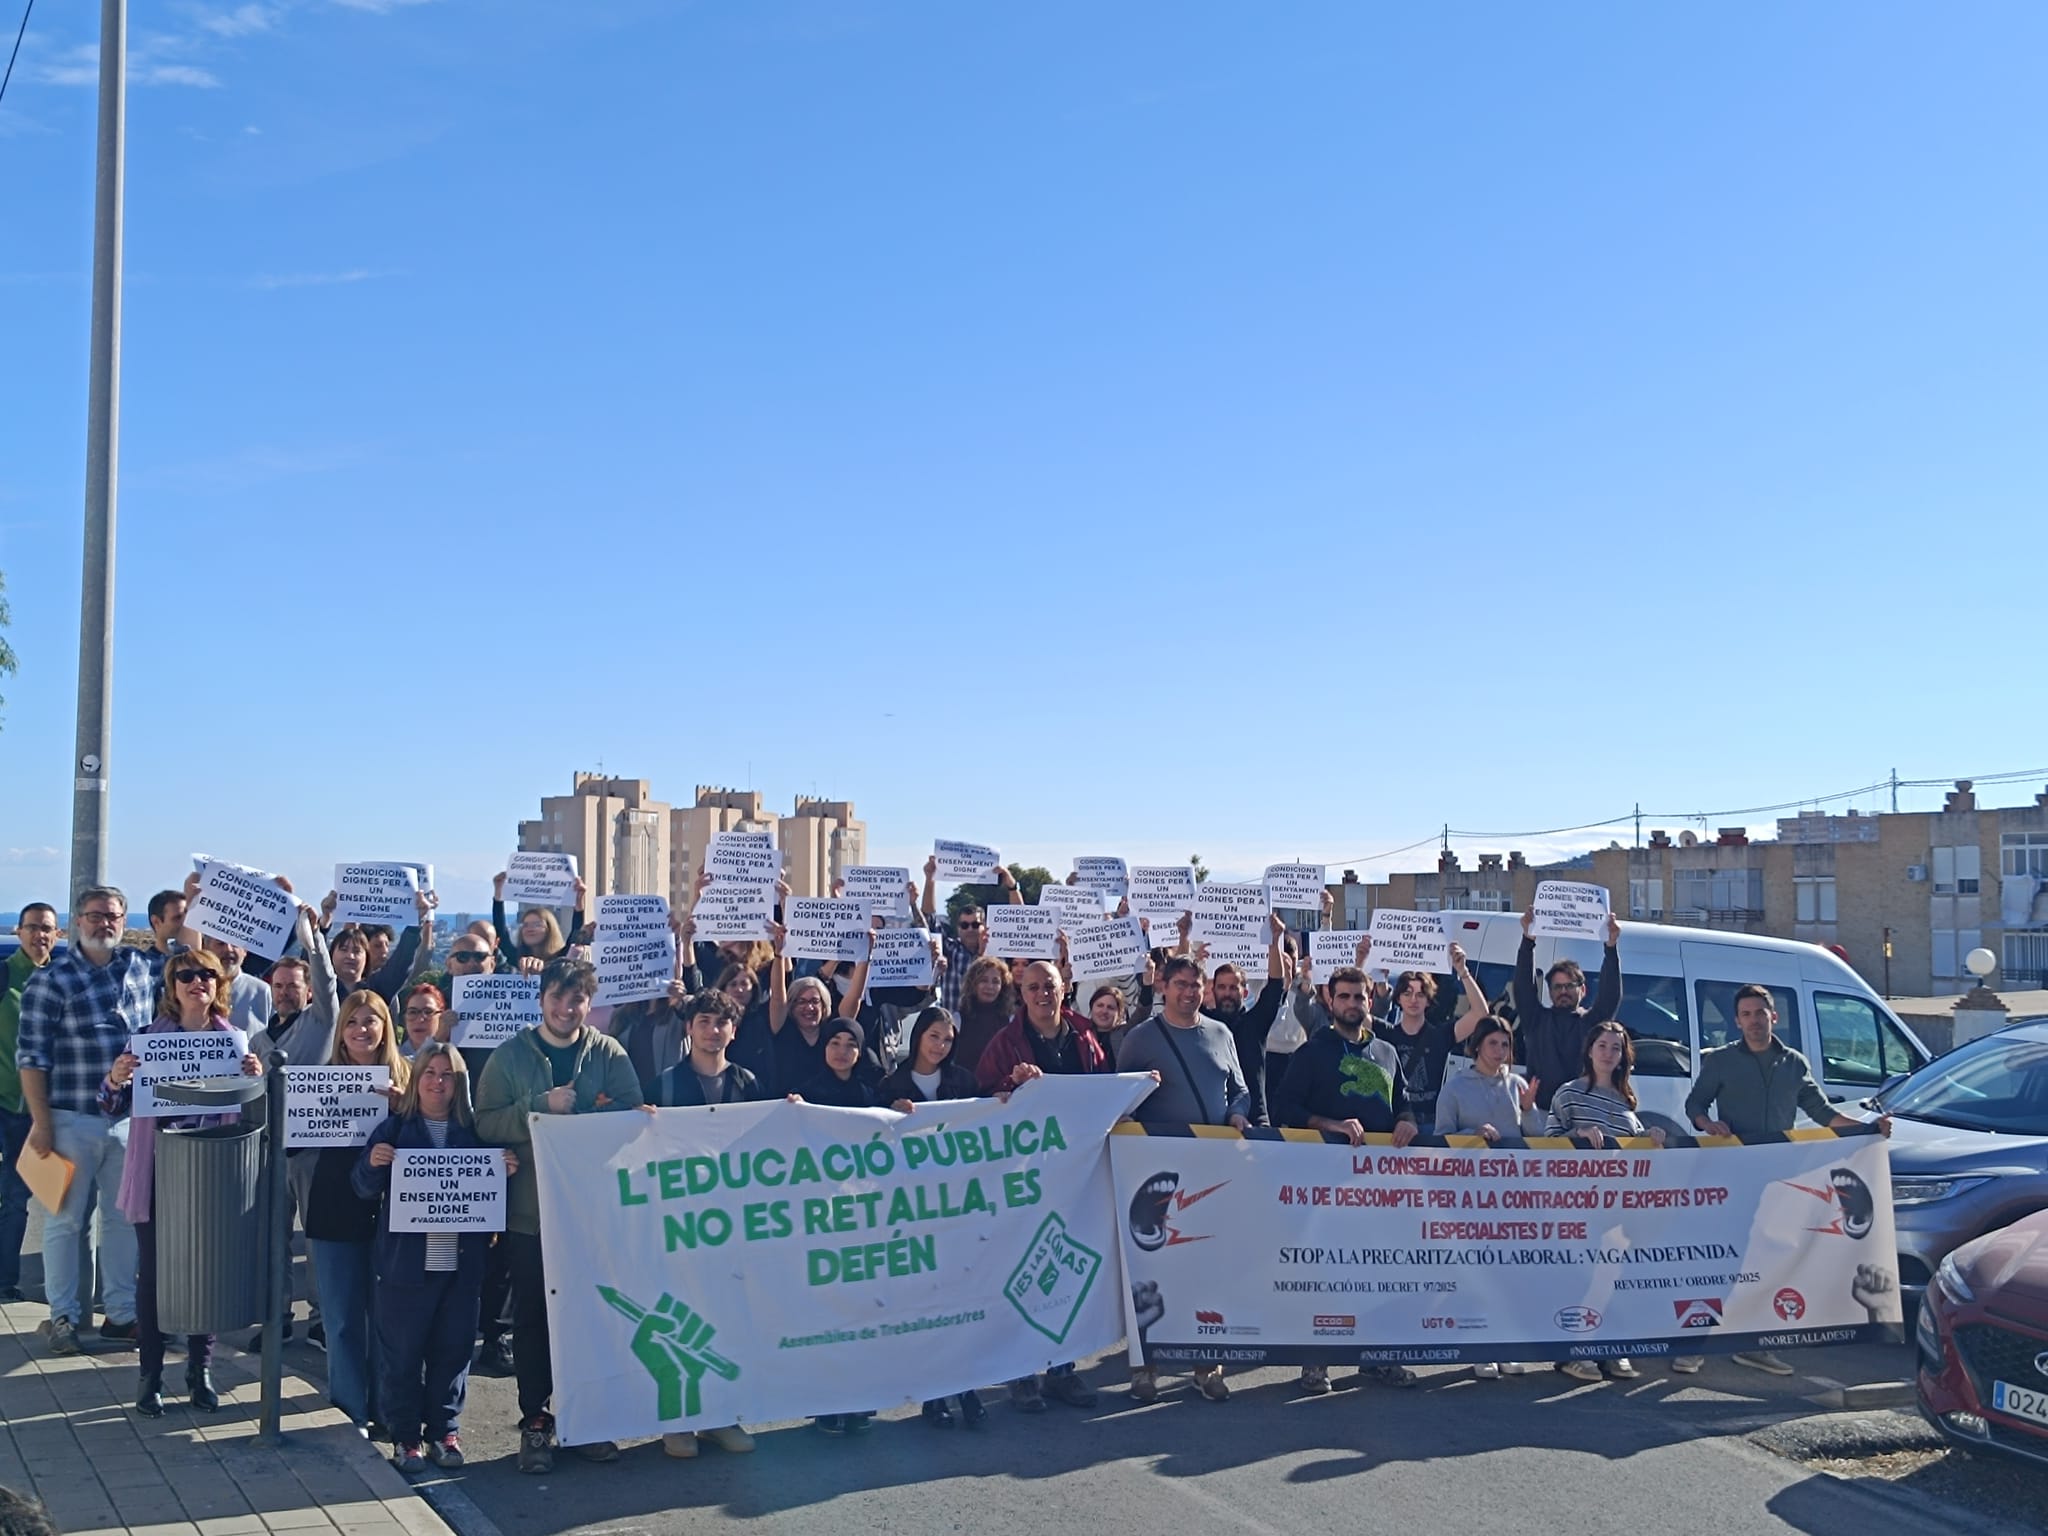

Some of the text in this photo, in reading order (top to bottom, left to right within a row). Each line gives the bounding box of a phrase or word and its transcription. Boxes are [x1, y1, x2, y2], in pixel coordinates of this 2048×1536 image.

[346, 867, 407, 878] CONDICIONS
[218, 870, 288, 904] CONDICIONS
[343, 876, 380, 885] DIGNES
[383, 879, 401, 887] PER
[210, 878, 287, 915] DIGNES PER A
[1202, 886, 1262, 896] CONDICIONS
[339, 894, 413, 905] ENSENYAMENT
[603, 898, 659, 906] CONDICIONS
[1198, 895, 1234, 904] DIGNES
[1237, 897, 1255, 905] PER
[236, 900, 254, 912] UN
[360, 904, 391, 912] DIGNE
[601, 906, 634, 914] DIGNES
[797, 902, 860, 911] CONDICIONS
[199, 896, 283, 935] ENSENYAMENT
[793, 911, 831, 919] DIGNES
[834, 912, 853, 920] PER
[1195, 912, 1267, 923] ENSENYAMENT
[1380, 913, 1442, 924] CONDICIONS
[218, 915, 255, 936] DIGNE
[600, 922, 666, 931] ENSENYAMENT
[1075, 921, 1132, 936] CONDICIONS
[1215, 922, 1245, 931] DIGNE
[1376, 922, 1412, 932] DIGNES
[1416, 925, 1434, 933] PER
[790, 929, 864, 939] ENSENYAMENT
[1073, 933, 1107, 945] DIGNES
[1110, 931, 1126, 939] PER
[603, 940, 665, 954] CONDICIONS
[811, 939, 842, 947] DIGNE
[1373, 939, 1446, 951] ENSENYAMENT
[600, 954, 639, 964] DIGNES
[642, 952, 658, 960] PER
[1072, 946, 1140, 962] ENSENYAMENT
[1393, 950, 1424, 959] DIGNE
[628, 963, 643, 971] UN
[1093, 957, 1123, 967] DIGNE
[598, 968, 669, 984] ENSENYAMENT
[466, 980, 538, 989] CONDICIONS
[618, 981, 649, 991] DIGNE
[463, 991, 507, 999] DIGNES
[511, 991, 528, 999] PER
[495, 1002, 511, 1010] UN
[460, 1012, 543, 1022] ENSENYAMENT
[484, 1023, 520, 1032] DIGNE
[147, 1037, 234, 1050] CONDICIONS
[144, 1049, 237, 1062] DIGNES PER A
[182, 1063, 200, 1073] UN
[288, 1072, 373, 1081] CONDICIONS
[338, 1084, 363, 1094] PER
[367, 1084, 376, 1093] A
[320, 1096, 339, 1105] UN
[288, 1107, 379, 1117] NSENYAMENT
[308, 1120, 349, 1129] DIGNE
[407, 1155, 492, 1165] CONDICIONS
[617, 1115, 1067, 1206] L'EDUCACIÓ PÚBLICA
[1353, 1155, 1373, 1175] LA
[1378, 1156, 1475, 1177] CONSELLERIA
[1479, 1153, 1519, 1177] ESTÀ
[1523, 1160, 1543, 1177] DE
[1546, 1159, 1627, 1178] REBAIXES
[403, 1167, 495, 1177] DIGNES PER A
[440, 1180, 459, 1189] UN
[400, 1192, 498, 1202] ENSENYAMENT
[1278, 1185, 1293, 1205] 41
[1296, 1187, 1308, 1205] %
[1312, 1186, 1331, 1206] DE
[1335, 1187, 1424, 1208] DESCOMPTE
[1427, 1190, 1456, 1208] PER
[1462, 1190, 1473, 1209] A
[1477, 1190, 1498, 1209] LA
[1502, 1185, 1599, 1209] CONTRACCIÓ
[1603, 1190, 1618, 1209] D'
[1622, 1188, 1690, 1209] EXPERTS
[428, 1204, 470, 1214] DIGNE
[664, 1168, 1042, 1253] NO ES RETALLA, ES
[1421, 1221, 1587, 1240] I ESPECIALISTES D' ERE
[807, 1229, 937, 1286] DEFÉN
[1279, 1246, 1324, 1264] STOP
[1325, 1248, 1337, 1264] A
[1337, 1247, 1360, 1265] LA
[1362, 1245, 1495, 1265] PRECARITZACIÓ
[1499, 1248, 1577, 1265] LABORAL
[1585, 1247, 1632, 1265] VAGA
[1634, 1243, 1739, 1264] INDEFINIDA
[1013, 1227, 1088, 1298] IES LAS LOMAS
[1273, 1277, 1353, 1293] MODIFICACIÓ
[1354, 1281, 1374, 1292] DEL
[1378, 1281, 1420, 1293] DECRET
[1614, 1277, 1672, 1291] REVERTIR
[1685, 1274, 1728, 1287] ORDRE
[1729, 1272, 1760, 1283] 9/2025
[1422, 1317, 1444, 1329] UGT
[1690, 1316, 1711, 1326] CGT
[779, 1309, 985, 1349] Assemblea de Treballadors/res
[1758, 1329, 1857, 1346] #NORETALLADESFP
[1570, 1343, 1669, 1357] #NORETALLADESFP
